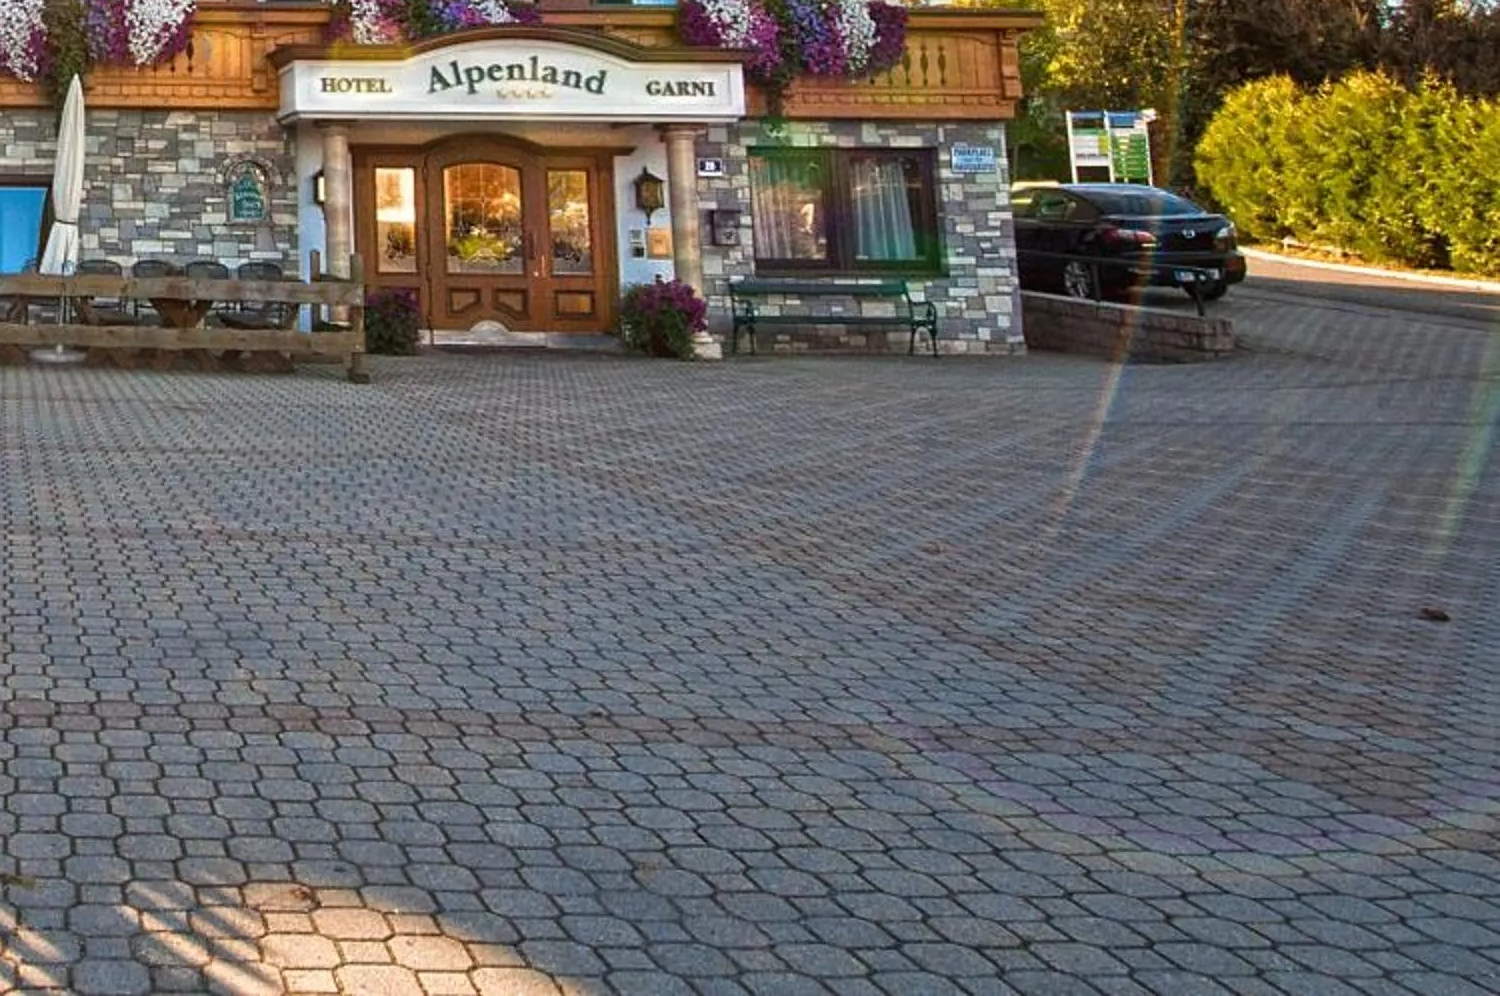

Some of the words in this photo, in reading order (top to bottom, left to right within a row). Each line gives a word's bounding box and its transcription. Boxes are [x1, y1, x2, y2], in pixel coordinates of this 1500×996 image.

[320, 77, 392, 93] HOTEL
[427, 56, 607, 95] Alpenland
[645, 80, 716, 97] GARNI
